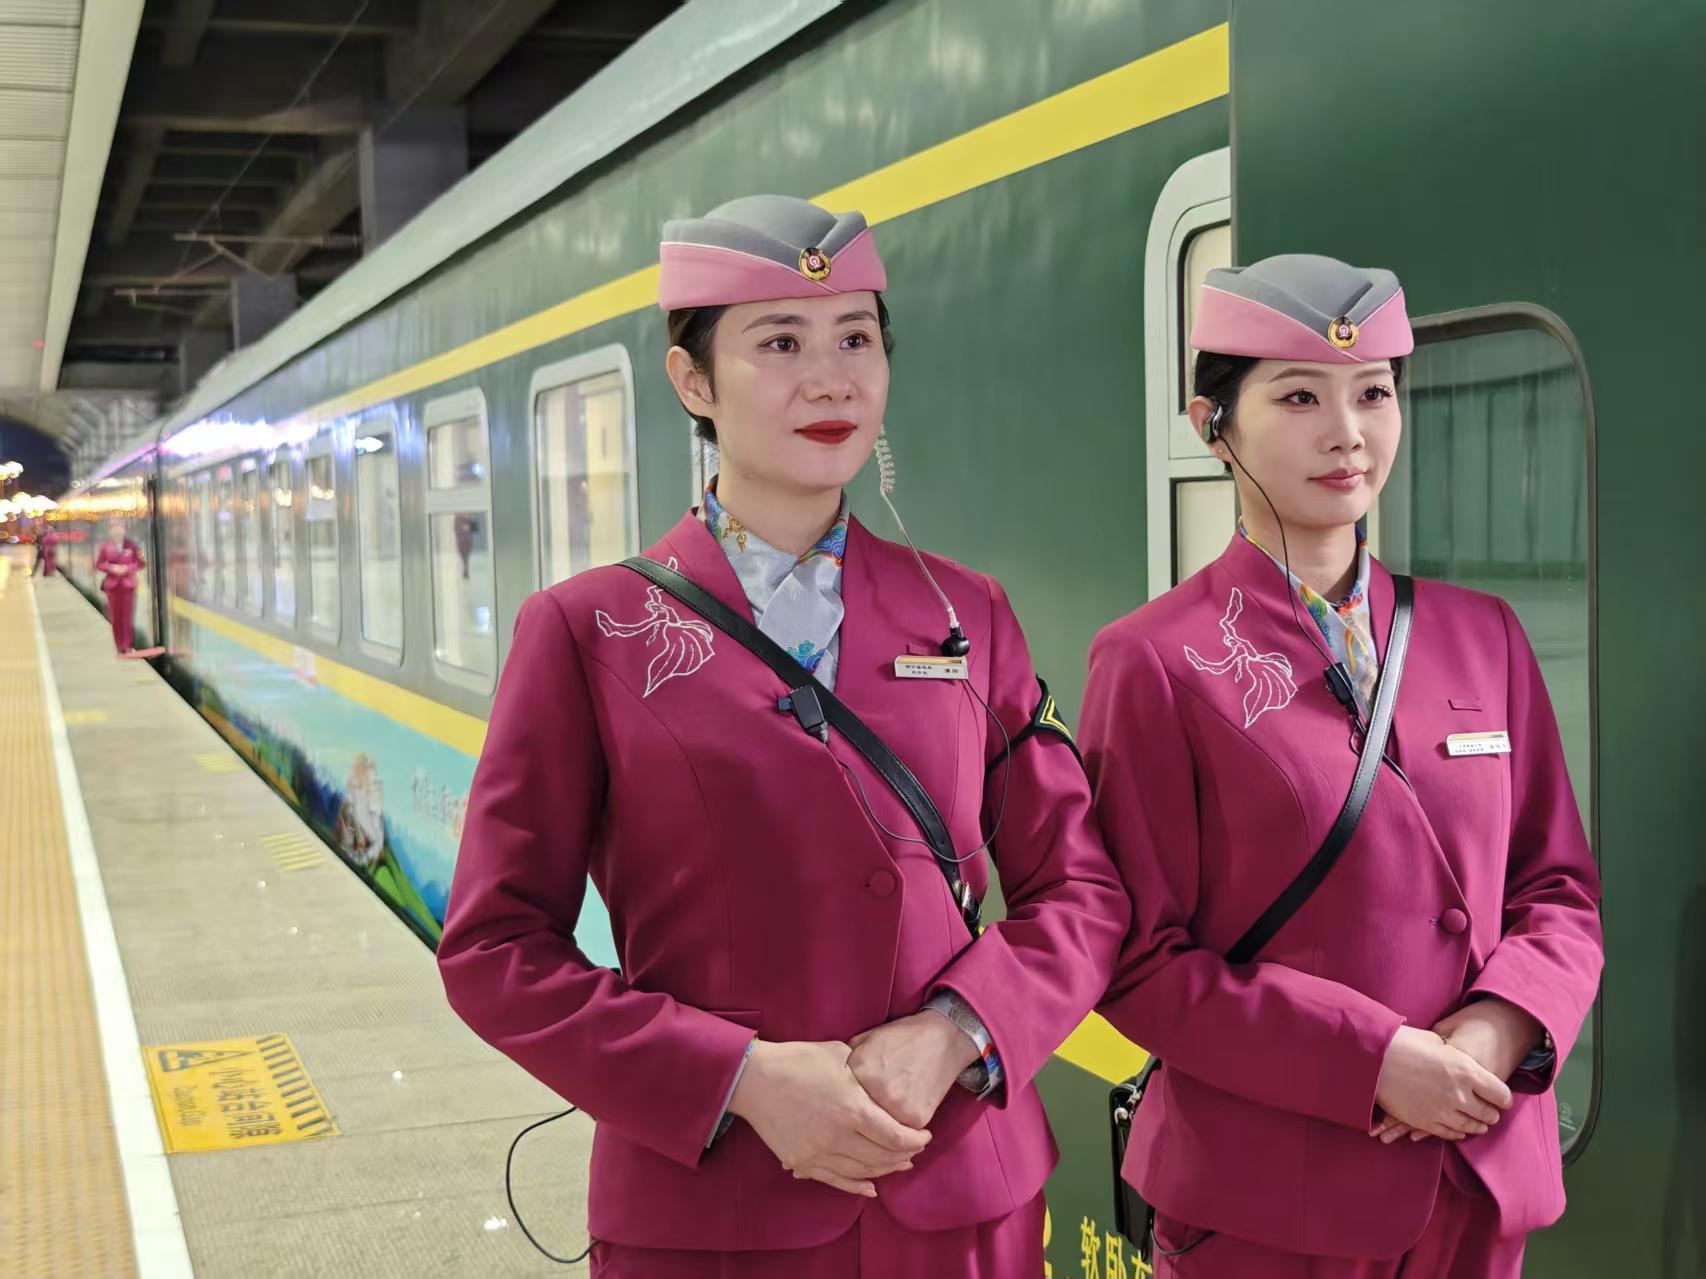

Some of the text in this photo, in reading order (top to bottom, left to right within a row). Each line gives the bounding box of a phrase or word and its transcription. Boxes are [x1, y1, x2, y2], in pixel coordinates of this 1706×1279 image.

[208, 1067, 283, 1139] 小心站台间隙
